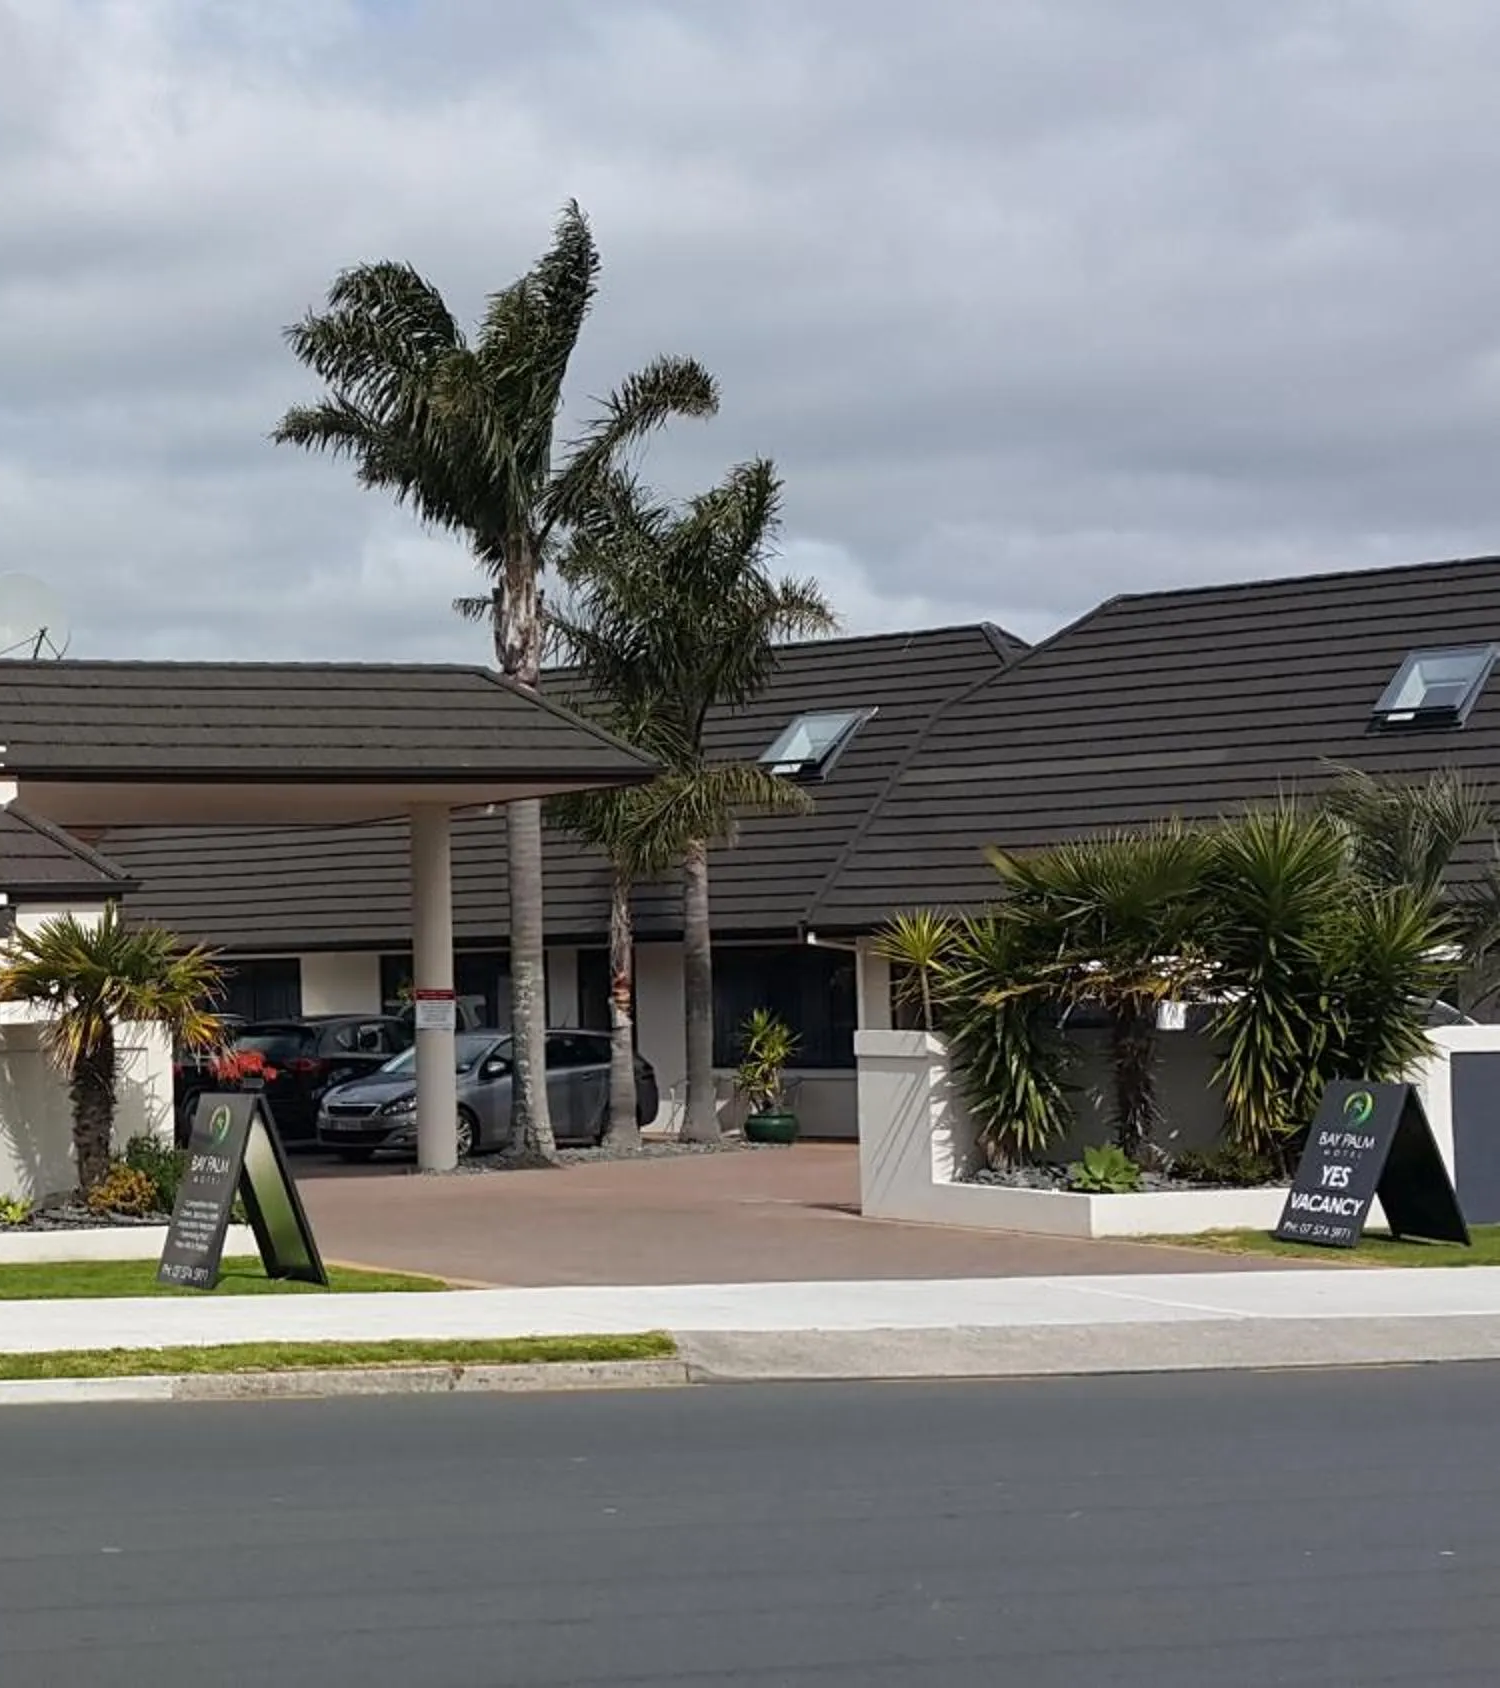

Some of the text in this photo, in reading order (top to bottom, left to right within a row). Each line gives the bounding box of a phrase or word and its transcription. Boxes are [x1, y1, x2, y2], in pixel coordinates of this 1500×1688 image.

[1319, 1131, 1375, 1150] BAY PALM
[191, 1154, 230, 1174] BAY PALM
[1320, 1165, 1352, 1188] YES
[1291, 1192, 1364, 1217] VACANCY
